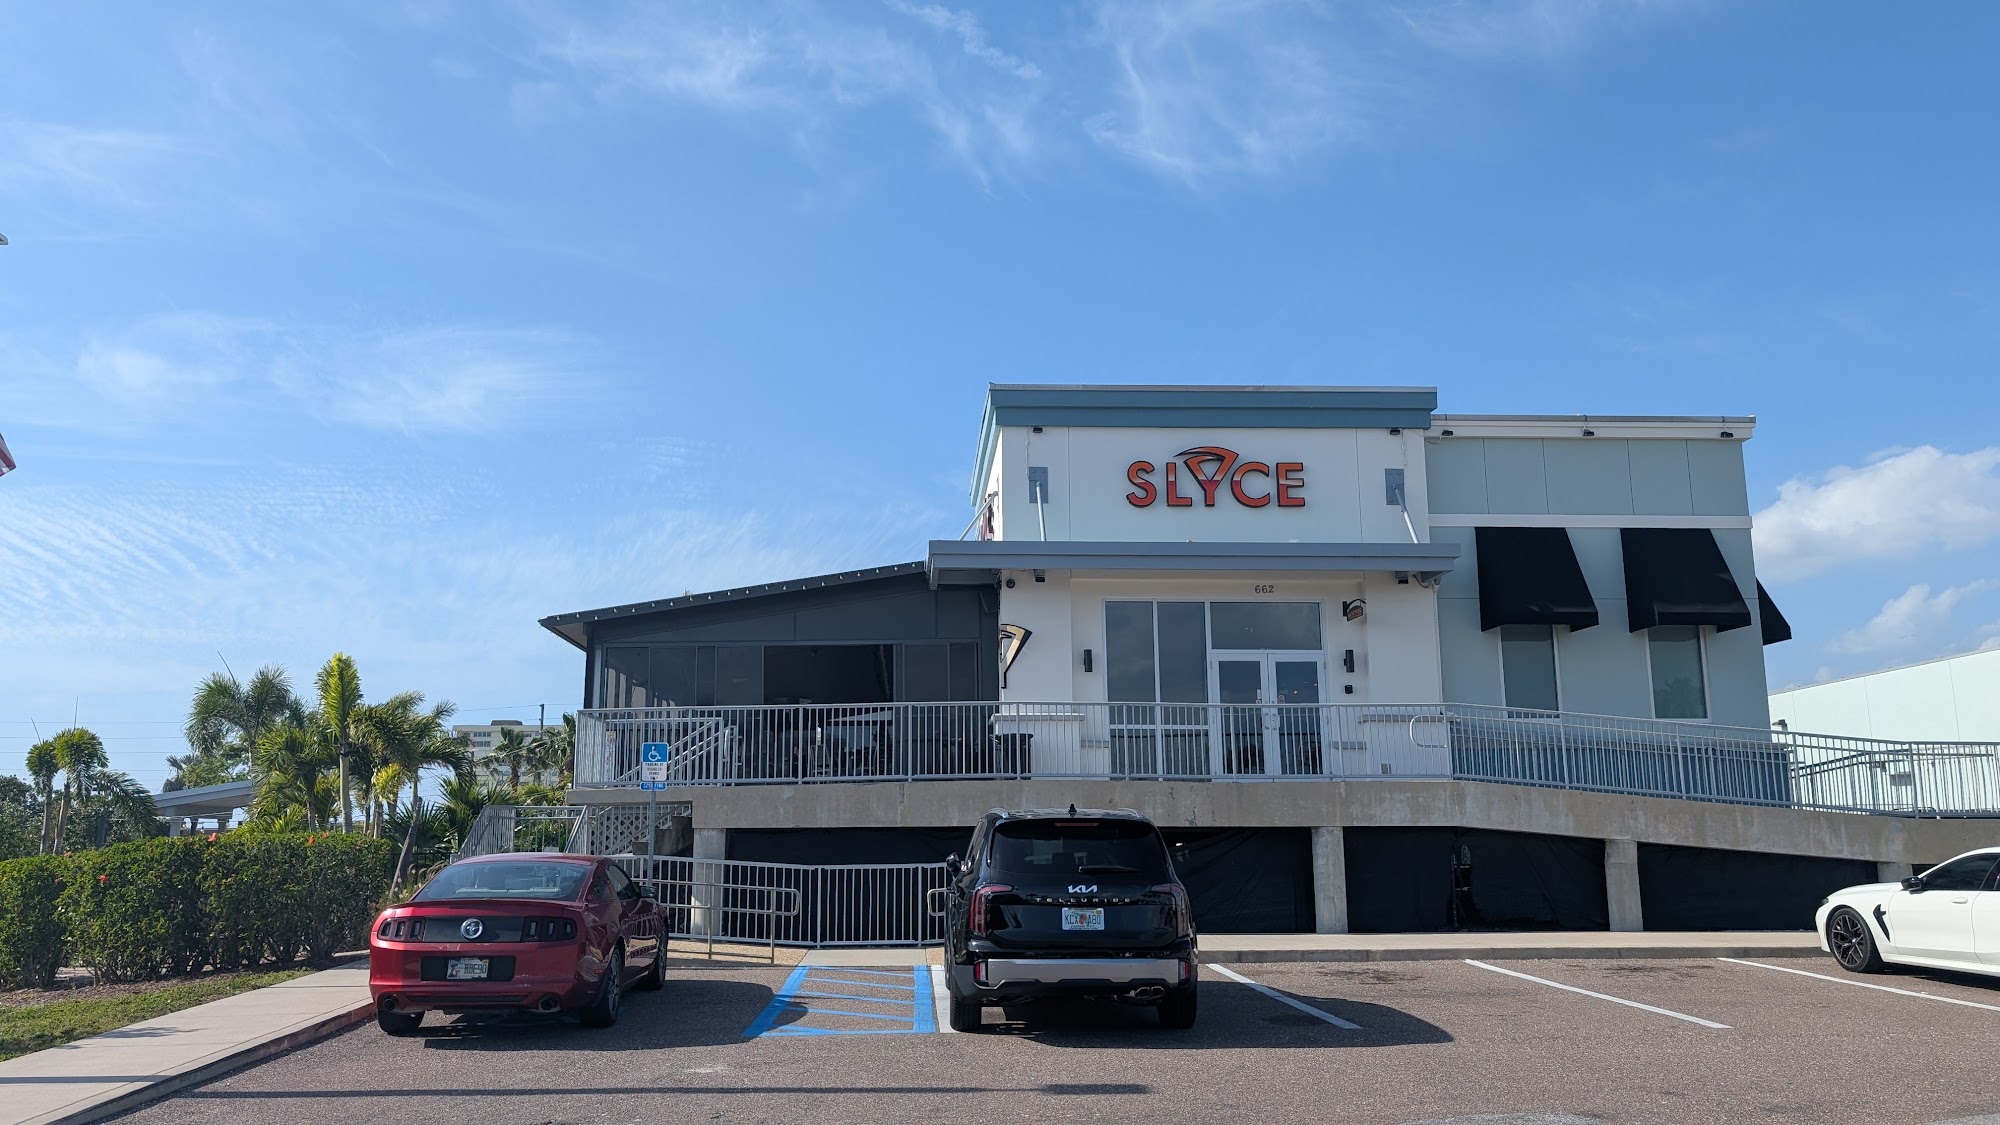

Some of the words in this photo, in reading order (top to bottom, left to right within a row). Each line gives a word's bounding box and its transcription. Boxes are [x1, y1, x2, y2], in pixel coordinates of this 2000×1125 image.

[1126, 446, 1306, 507] SLYCE
[1254, 584, 1274, 594] 662
[1068, 885, 1098, 893] KIA
